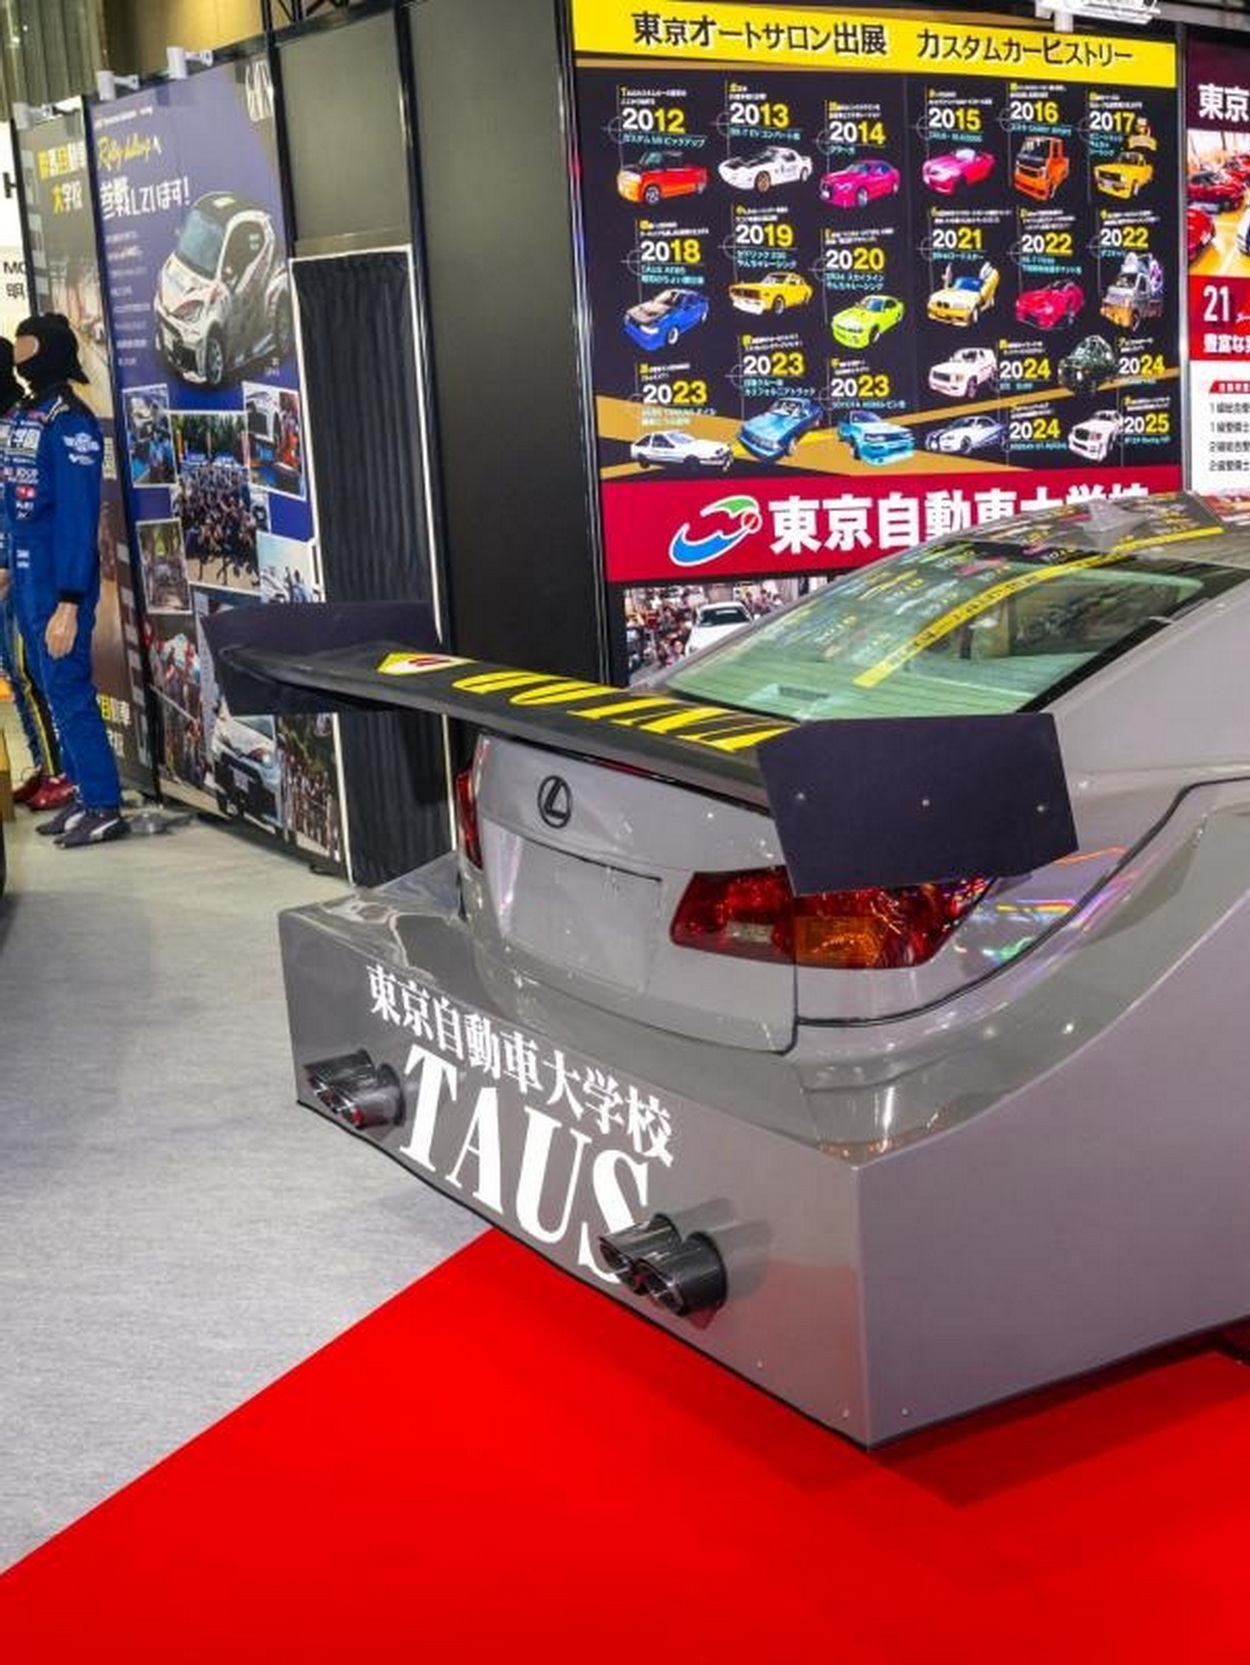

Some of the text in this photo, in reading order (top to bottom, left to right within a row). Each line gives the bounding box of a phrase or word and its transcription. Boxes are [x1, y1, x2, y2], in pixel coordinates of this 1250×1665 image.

[632, 12, 1133, 67] 東京オートサロン出展 カスタムカーヒストリー
[622, 107, 685, 134] 2012
[730, 102, 789, 128] 2013
[929, 107, 981, 130] 2015
[1011, 101, 1059, 123] 2016
[1089, 111, 1136, 133] 2017
[830, 121, 886, 145] 2014
[735, 223, 793, 246] 2019
[932, 226, 982, 250] 2021
[1022, 232, 1073, 255] 2022
[1100, 226, 1149, 248] 2022
[640, 238, 701, 264] 2018
[825, 247, 885, 271] 2020
[1203, 285, 1230, 323] 21
[743, 352, 804, 376] 2023
[1000, 358, 1051, 379] 2024
[1119, 355, 1166, 375] 2024
[643, 381, 707, 405] 2023
[831, 374, 890, 397] 2023
[1009, 419, 1061, 440] 2024
[1124, 413, 1170, 434] 2025
[365, 962, 675, 1169] 東京自動車大学校
[399, 1042, 653, 1284] TAUS
